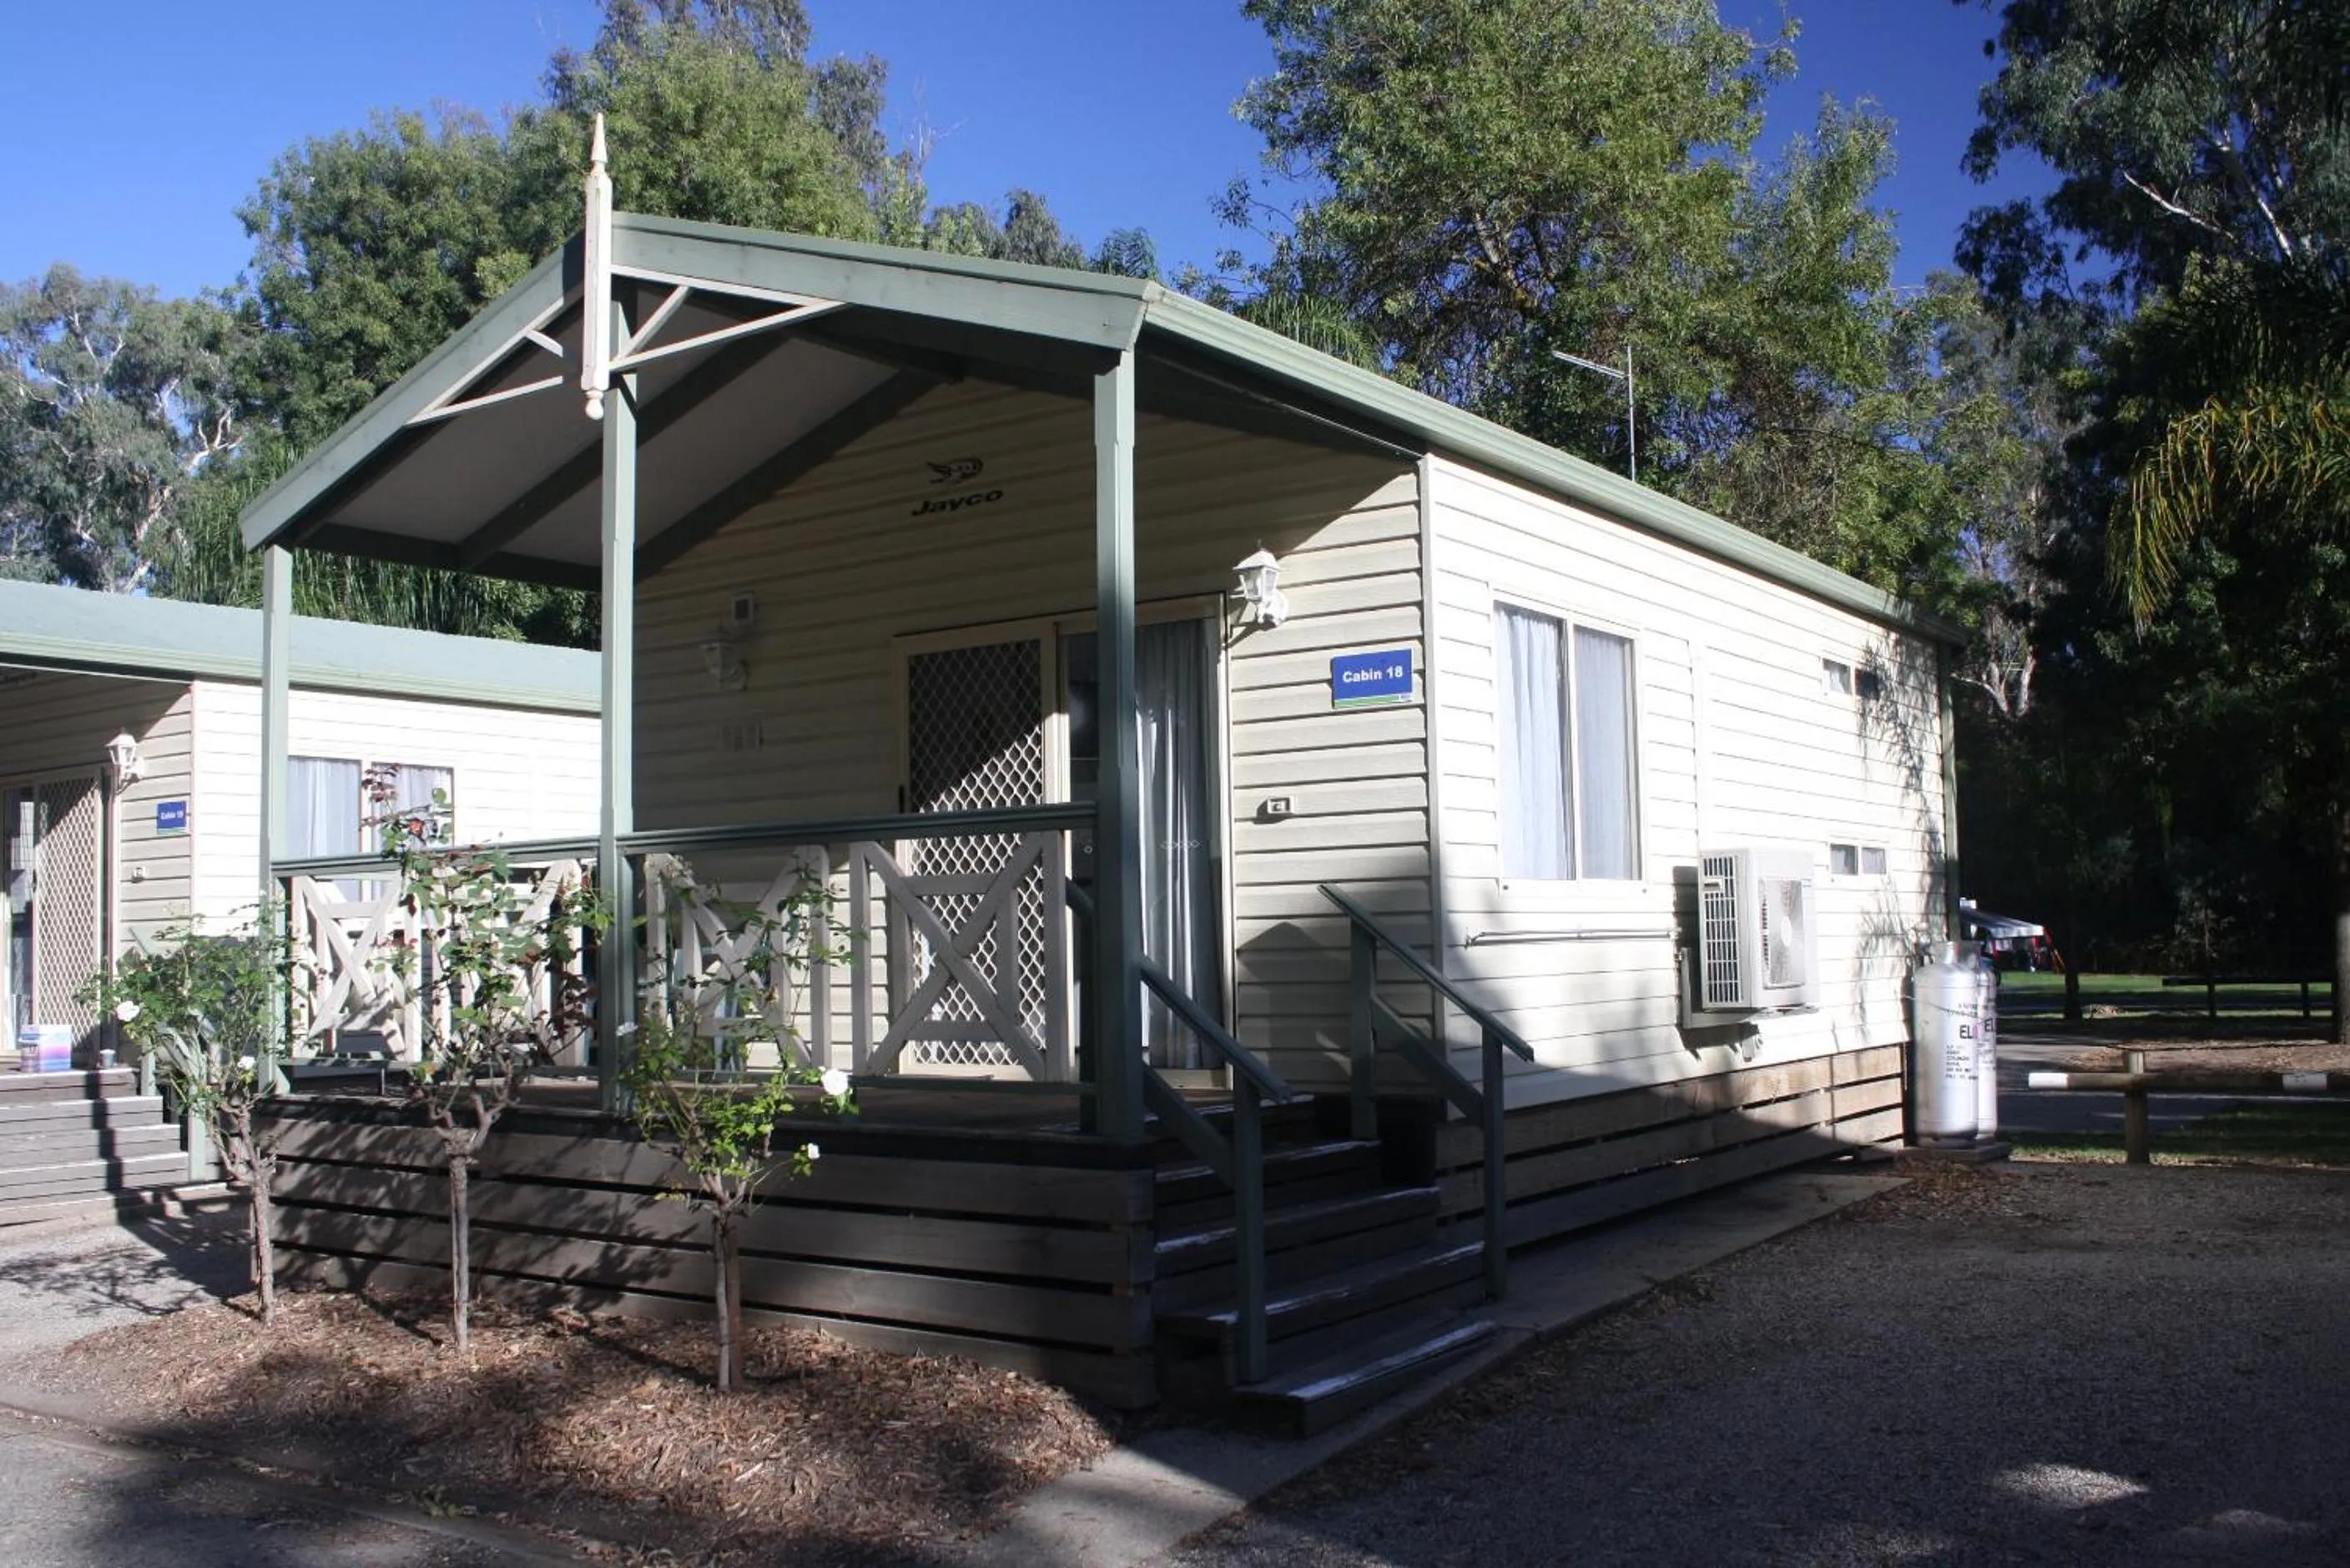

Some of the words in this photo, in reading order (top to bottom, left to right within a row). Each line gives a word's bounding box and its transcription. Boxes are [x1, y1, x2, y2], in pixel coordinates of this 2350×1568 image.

[911, 490, 1003, 516] Jayco
[1342, 668, 1383, 683] Cabin
[1386, 665, 1403, 678] 18
